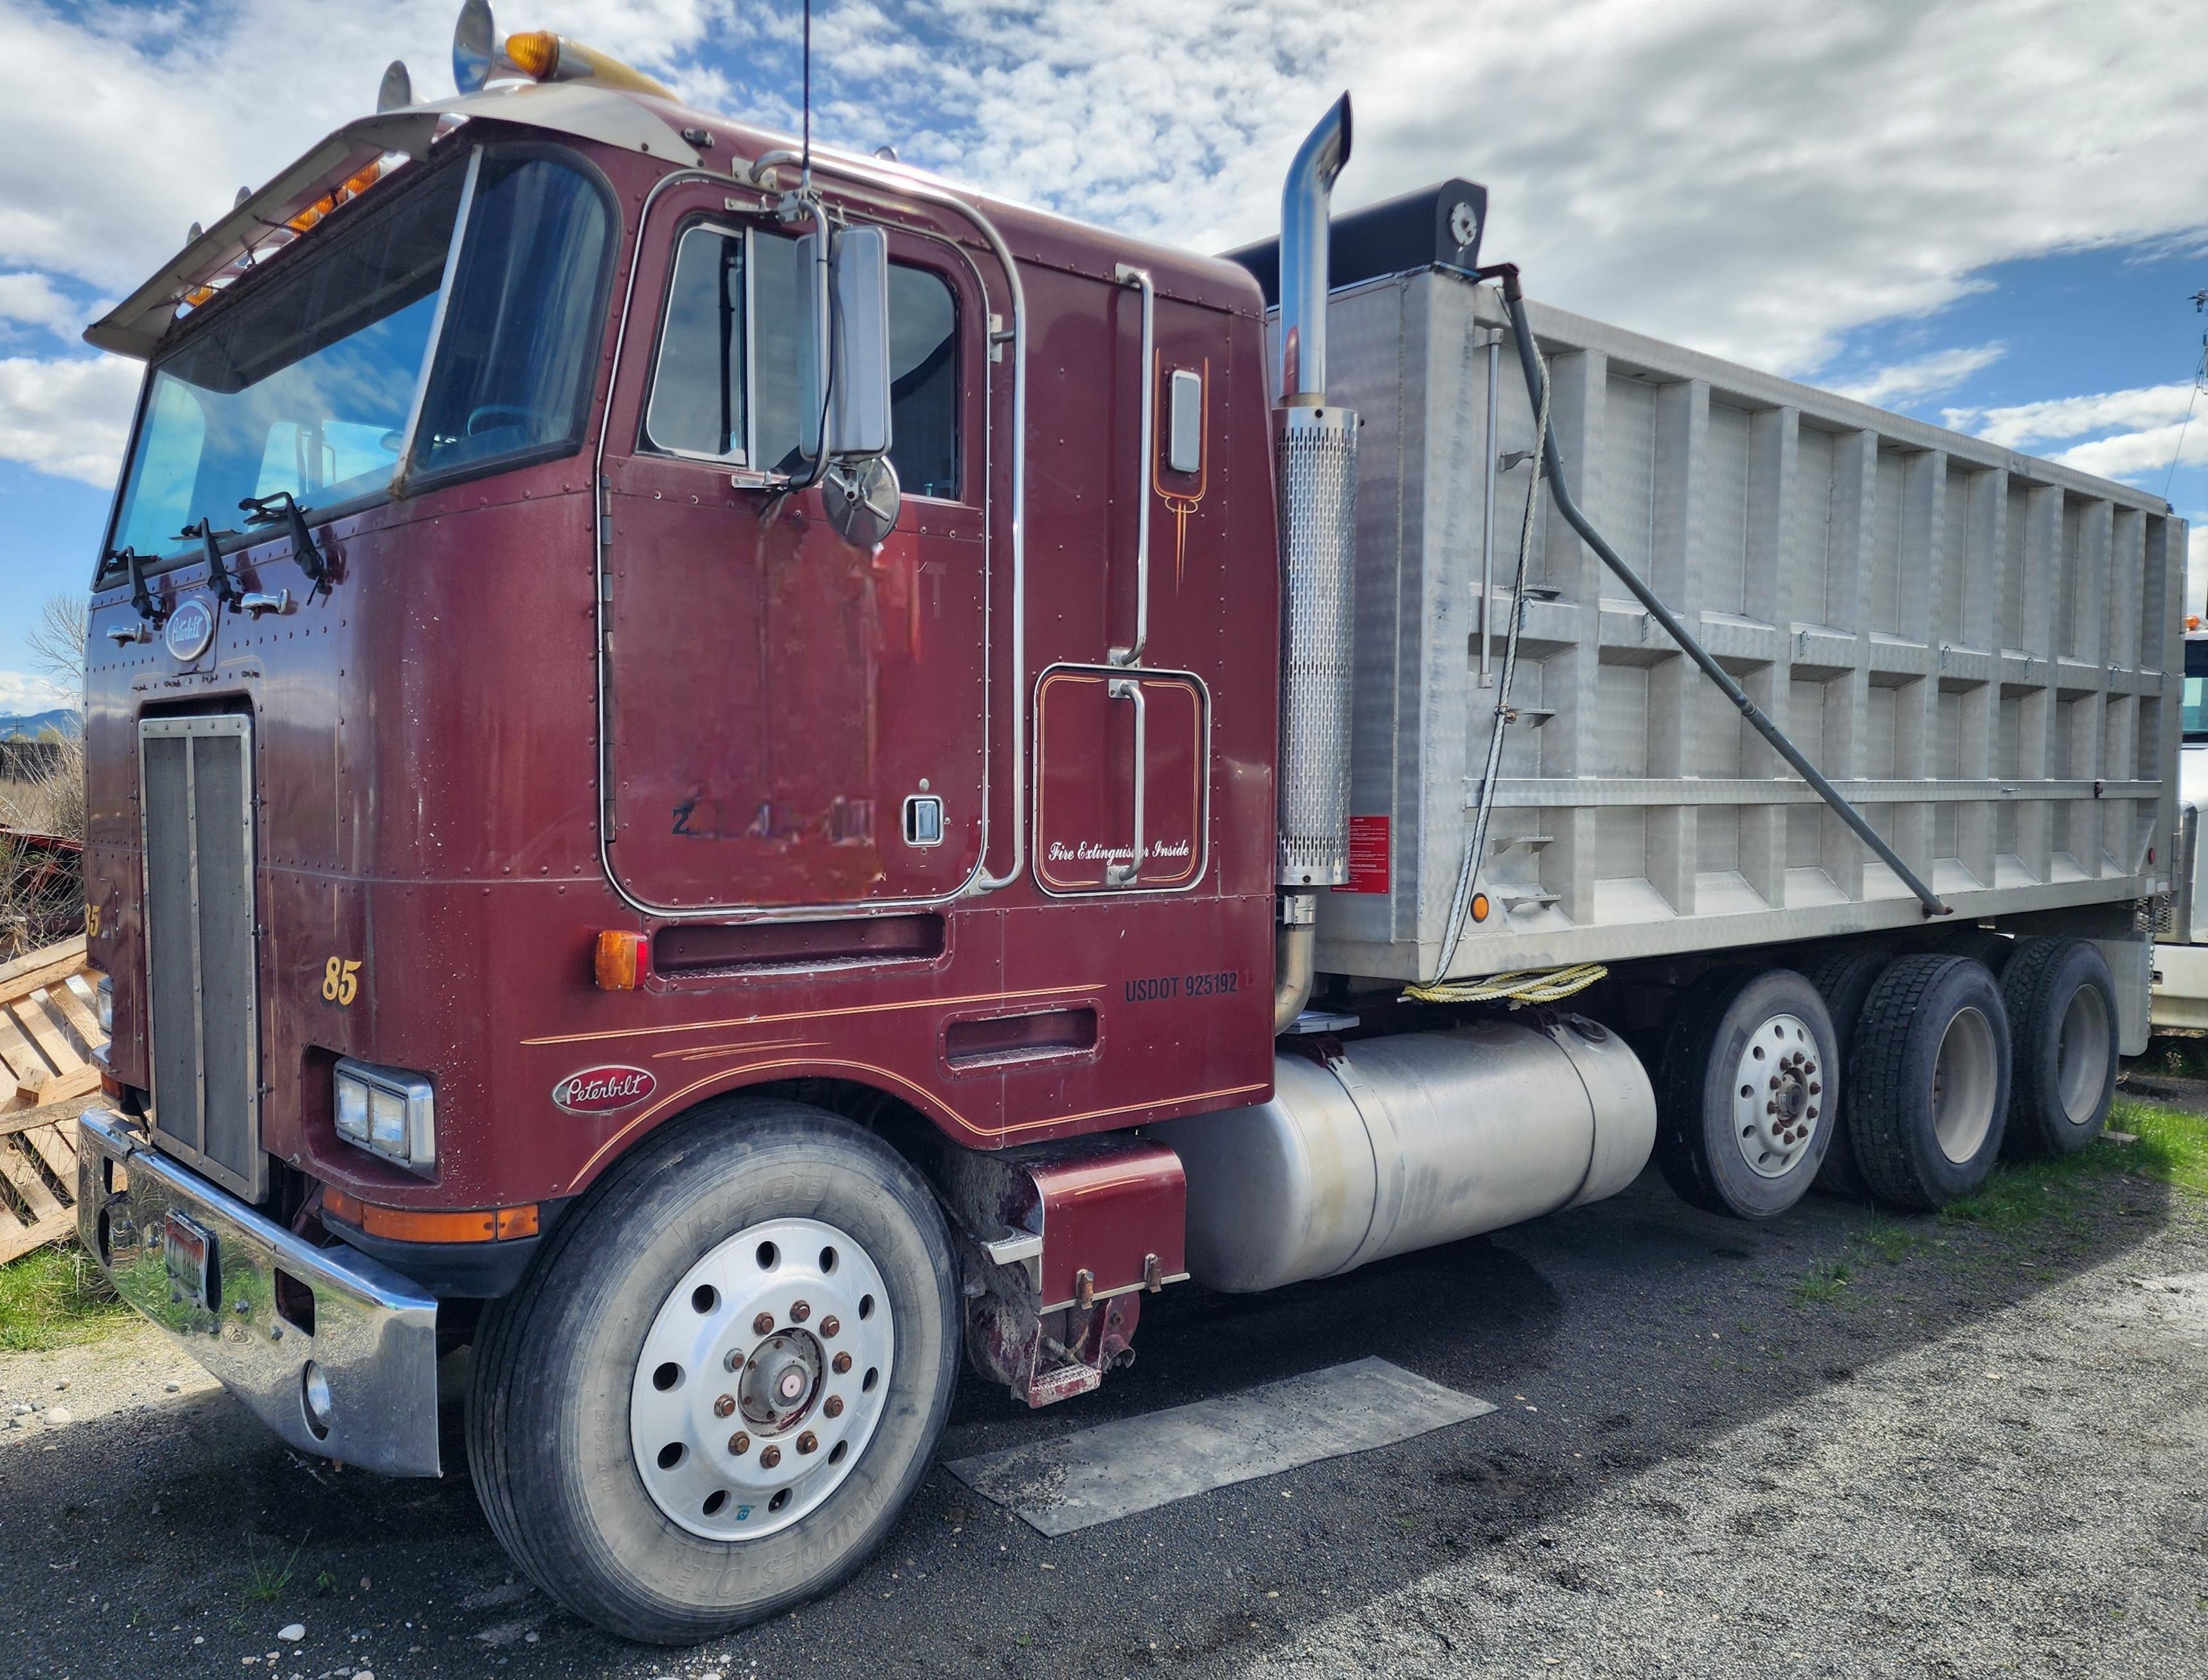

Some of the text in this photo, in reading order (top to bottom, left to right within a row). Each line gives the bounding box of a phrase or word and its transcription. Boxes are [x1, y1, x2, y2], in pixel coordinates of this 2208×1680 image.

[1048, 839, 1189, 866] Fire Extinguisr Inside
[322, 956, 363, 1006] 85
[1125, 972, 1237, 1002] USDOT 925192
[566, 1075, 648, 1105] Peterbilt
[674, 1480, 888, 1598] BRIDGESTONE
